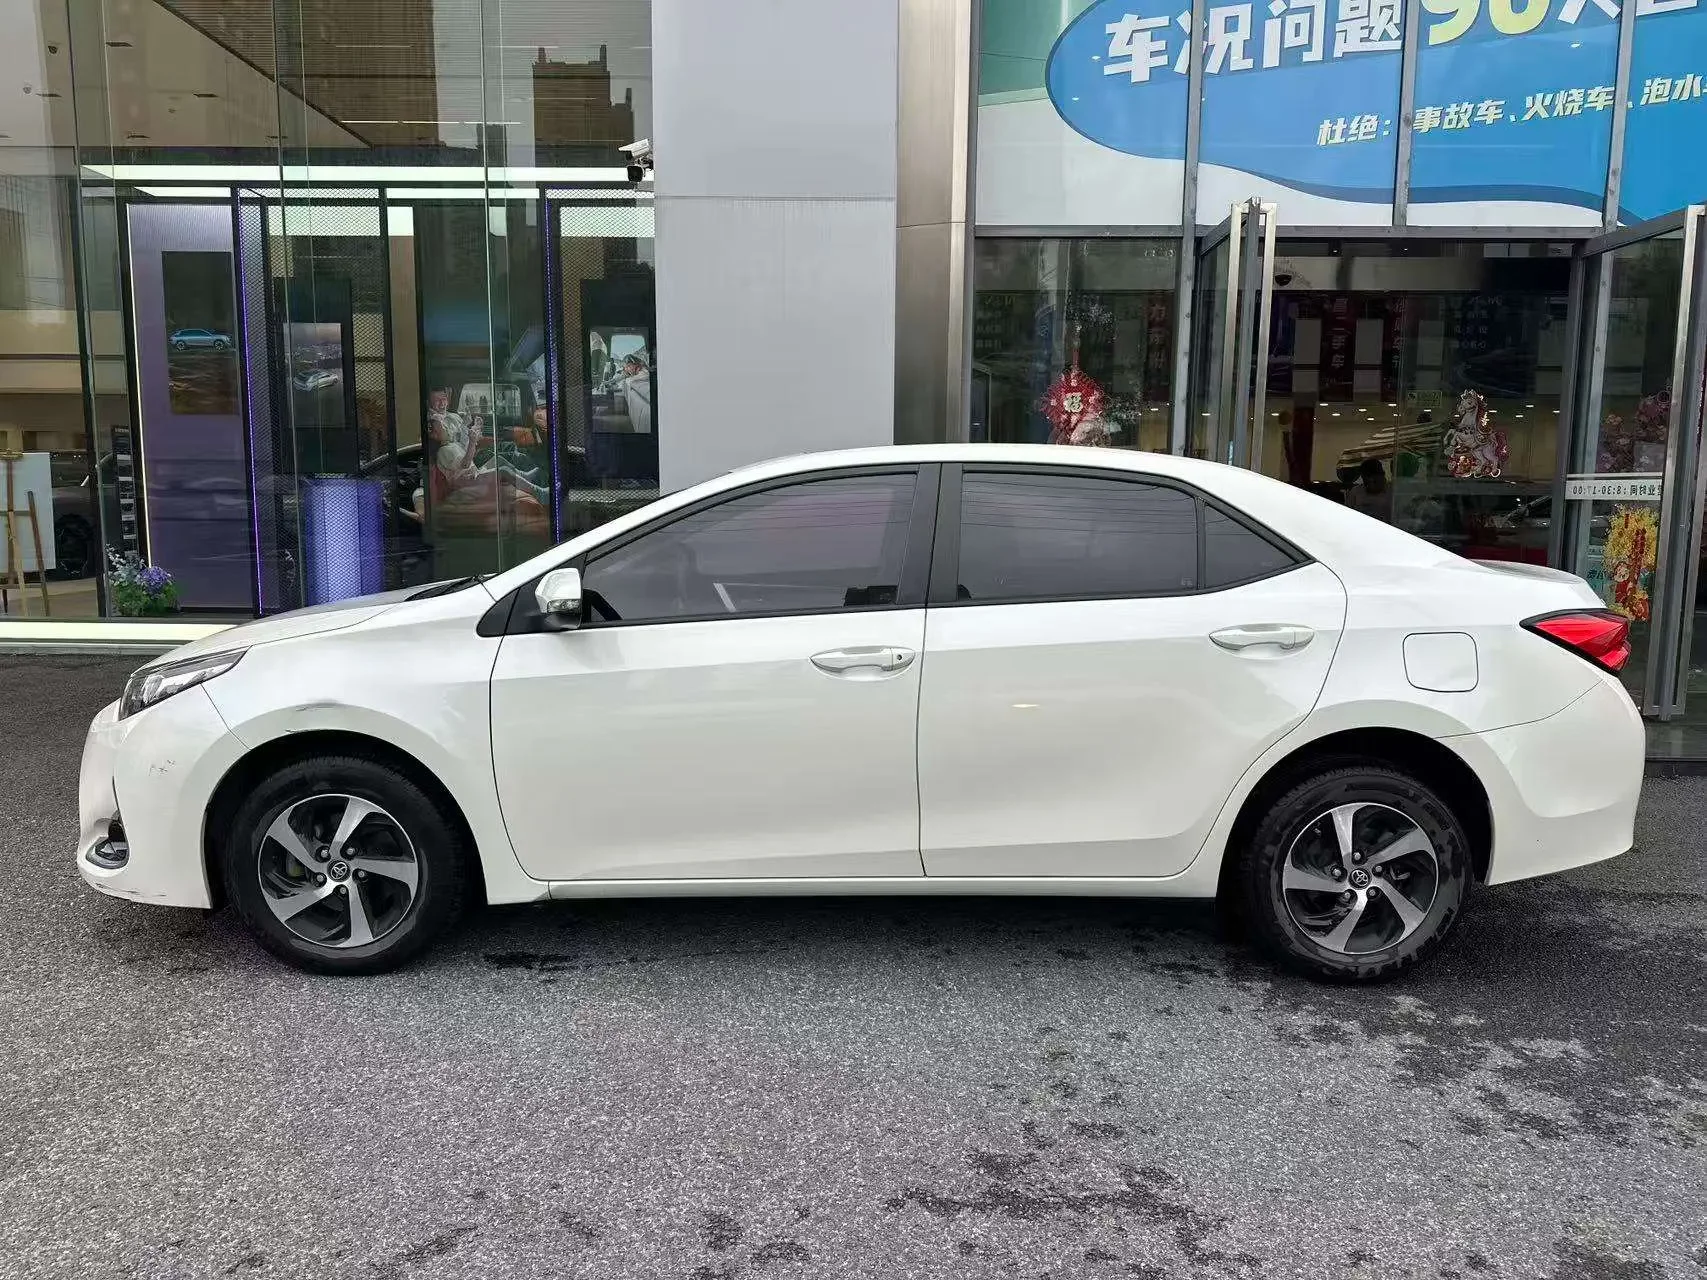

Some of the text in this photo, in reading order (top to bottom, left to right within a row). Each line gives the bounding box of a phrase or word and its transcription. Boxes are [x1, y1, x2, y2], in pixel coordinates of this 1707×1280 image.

[1315, 73, 1707, 146] 杜绝：事故车、火烧车、泡水
